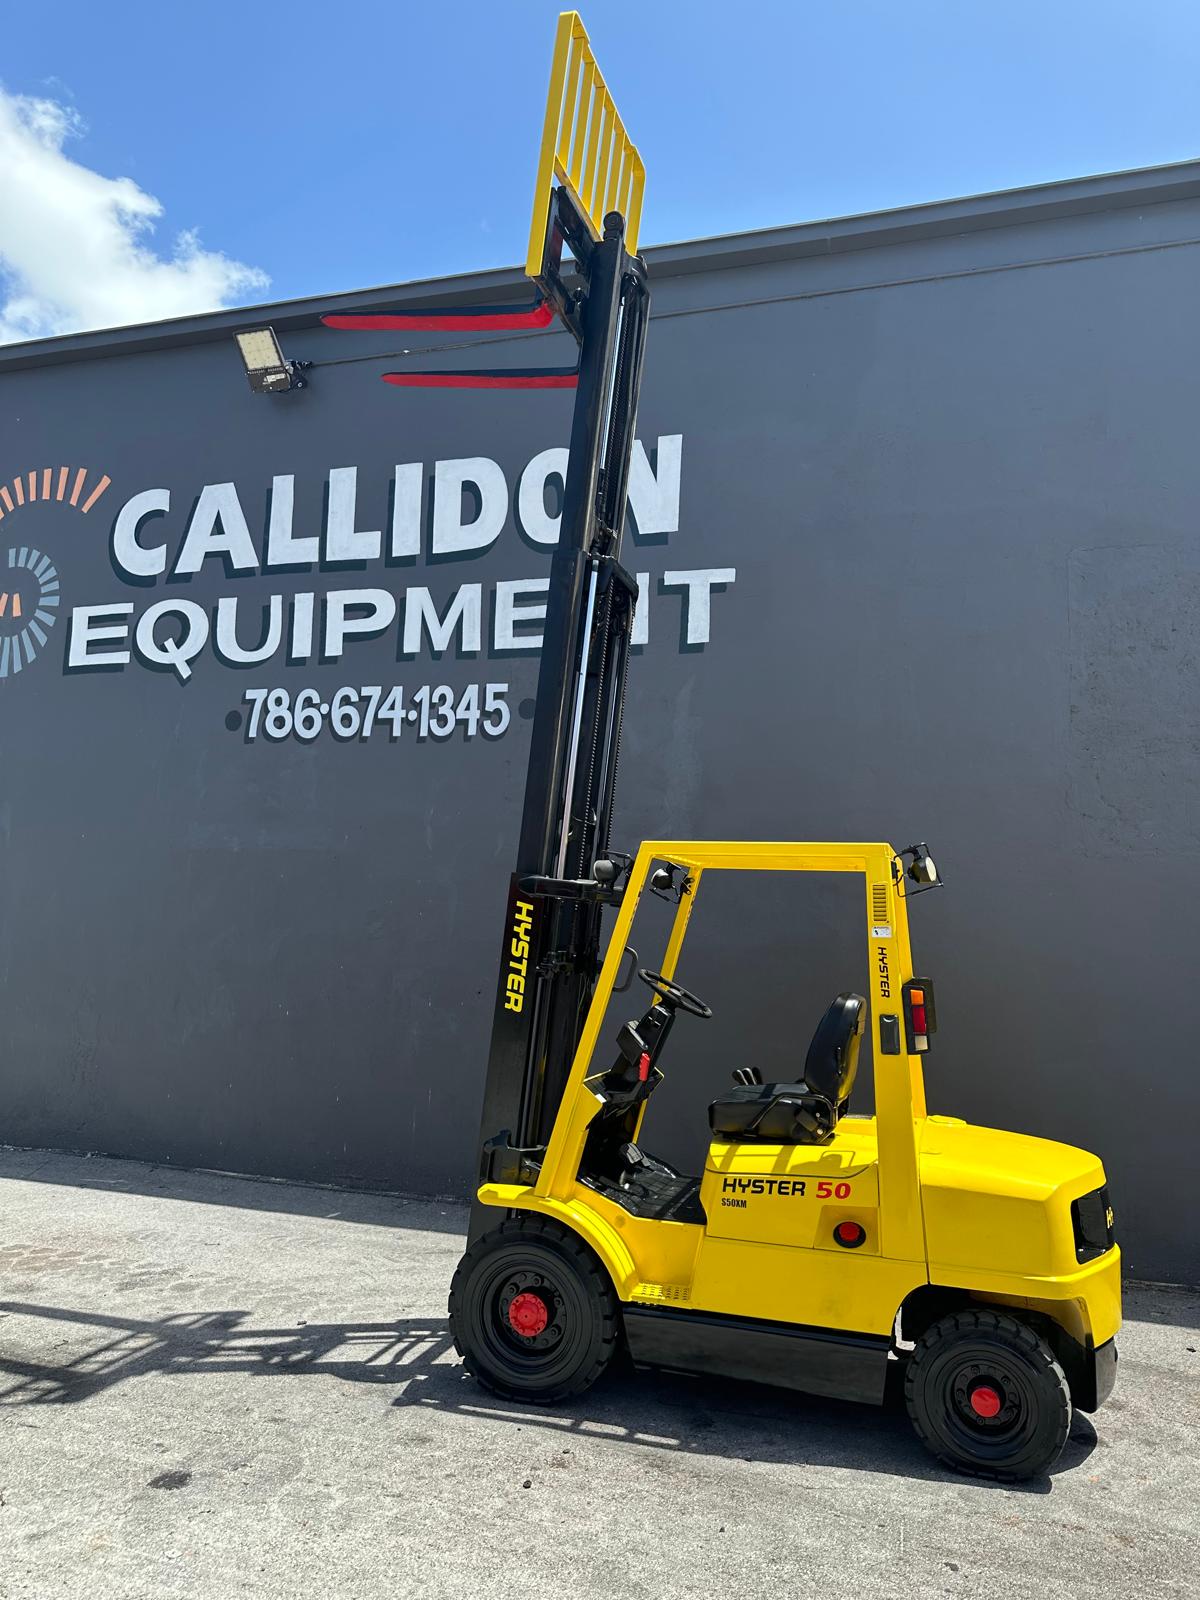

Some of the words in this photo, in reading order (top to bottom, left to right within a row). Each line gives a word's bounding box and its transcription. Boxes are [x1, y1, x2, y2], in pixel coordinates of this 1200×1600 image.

[113, 433, 683, 577] CALLIDON
[504, 900, 534, 1013] HYSTER
[877, 946, 891, 999] HYSTER
[721, 1197, 747, 1209] S50XM
[722, 1177, 807, 1197] HYSTER
[815, 1181, 852, 1200] 50
